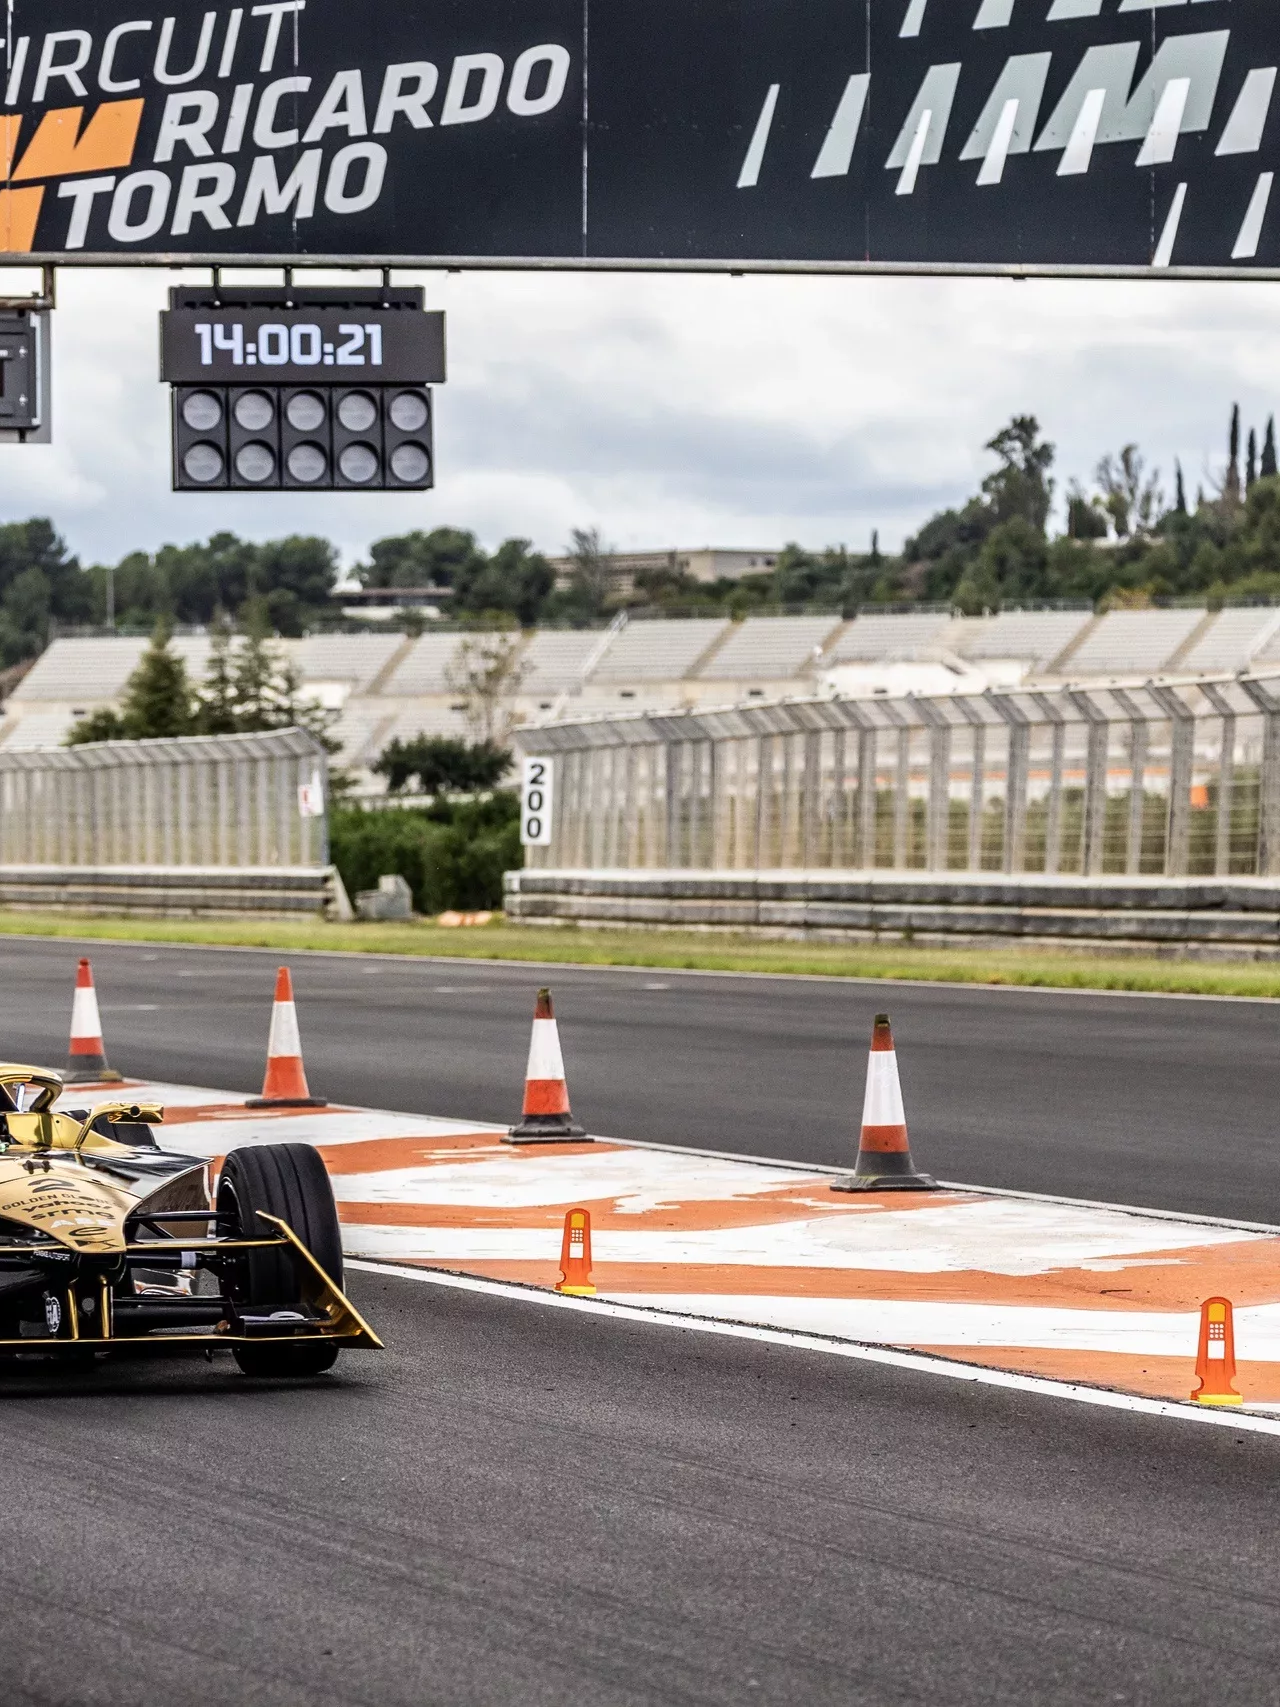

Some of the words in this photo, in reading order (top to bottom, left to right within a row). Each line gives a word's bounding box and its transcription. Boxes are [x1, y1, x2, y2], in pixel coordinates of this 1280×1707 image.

[153, 43, 571, 163] RICARDO
[56, 141, 388, 250] TORMO
[194, 323, 383, 366] 14:00:21
[526, 763, 546, 839] 200
[2, 1193, 58, 1211] GOLDEN
